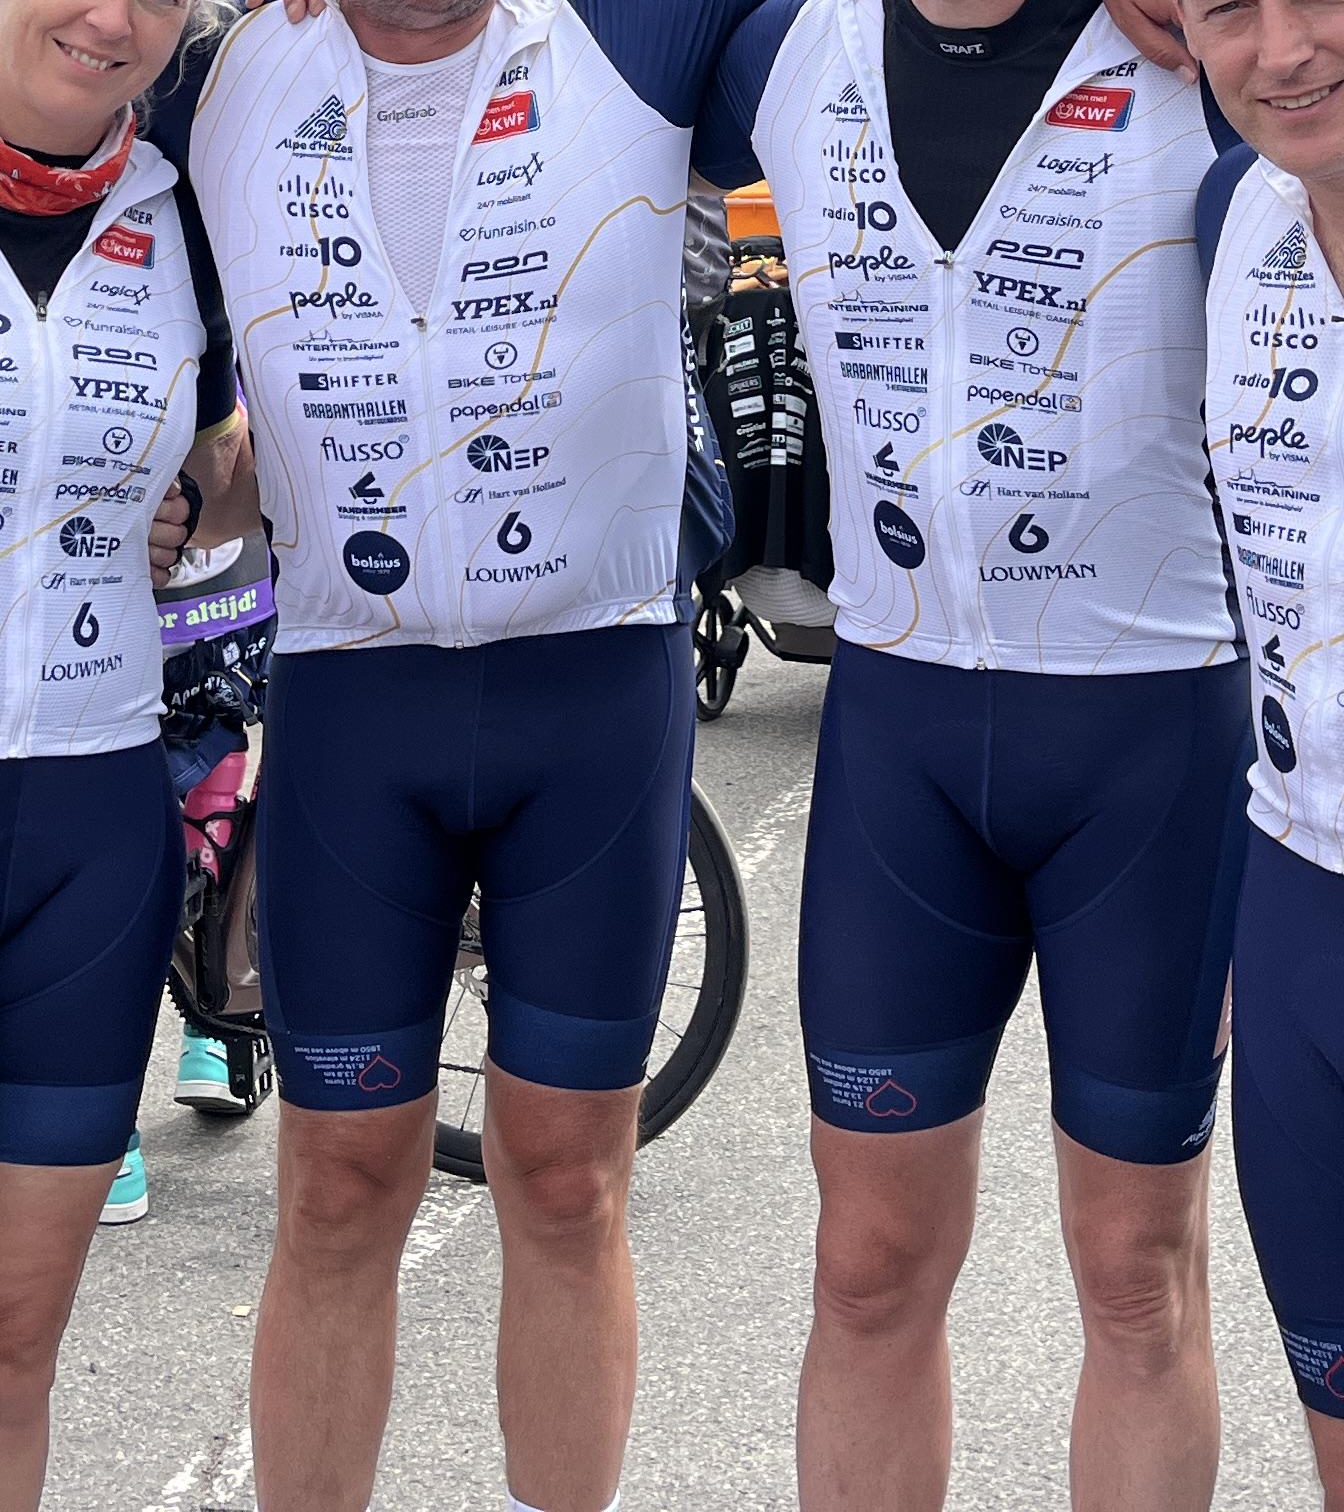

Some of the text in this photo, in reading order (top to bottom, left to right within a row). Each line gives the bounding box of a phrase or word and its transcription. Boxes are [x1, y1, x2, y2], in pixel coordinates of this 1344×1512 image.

[377, 105, 436, 122] GripGrab
[830, 167, 885, 183] CISCO
[287, 202, 349, 219] CISCO
[1016, 209, 1103, 230] funraisin.co
[477, 215, 555, 240] funraisin.co
[973, 271, 1087, 312] YPEX.nl
[451, 291, 558, 321] YPEX.nl
[828, 303, 929, 312] INTERTRAINING
[293, 341, 399, 351] INTERTRAINING
[852, 335, 924, 351] SHIFTER
[1250, 331, 1318, 350] CISCO
[448, 368, 556, 389] BIKE Totaal
[841, 361, 928, 384] BRABANTHALLEN
[969, 353, 1078, 382] BIKE Totaal
[70, 377, 167, 410] YPEX.nl
[318, 373, 398, 389] SHIFTER
[303, 400, 407, 420] BRABANTHALLEN
[450, 395, 540, 422] papendal
[967, 385, 1058, 411] papendal
[854, 399, 920, 435] flusso
[62, 456, 106, 467] BIKE
[321, 436, 403, 462] flusso
[493, 446, 550, 472] NEP
[1002, 448, 1068, 472] NEP
[1282, 453, 1310, 463] VISMA
[497, 510, 532, 554] 6
[880, 519, 918, 545] bolsius
[1008, 514, 1049, 554] 6
[1243, 517, 1307, 544] SHIFTER
[351, 553, 400, 569] bolsius
[465, 554, 568, 585] LOUWMAN
[980, 564, 1097, 582] LOUWMAN
[186, 589, 256, 626] altijd!
[72, 602, 99, 648] 6
[41, 654, 123, 682] LOUWMAN
